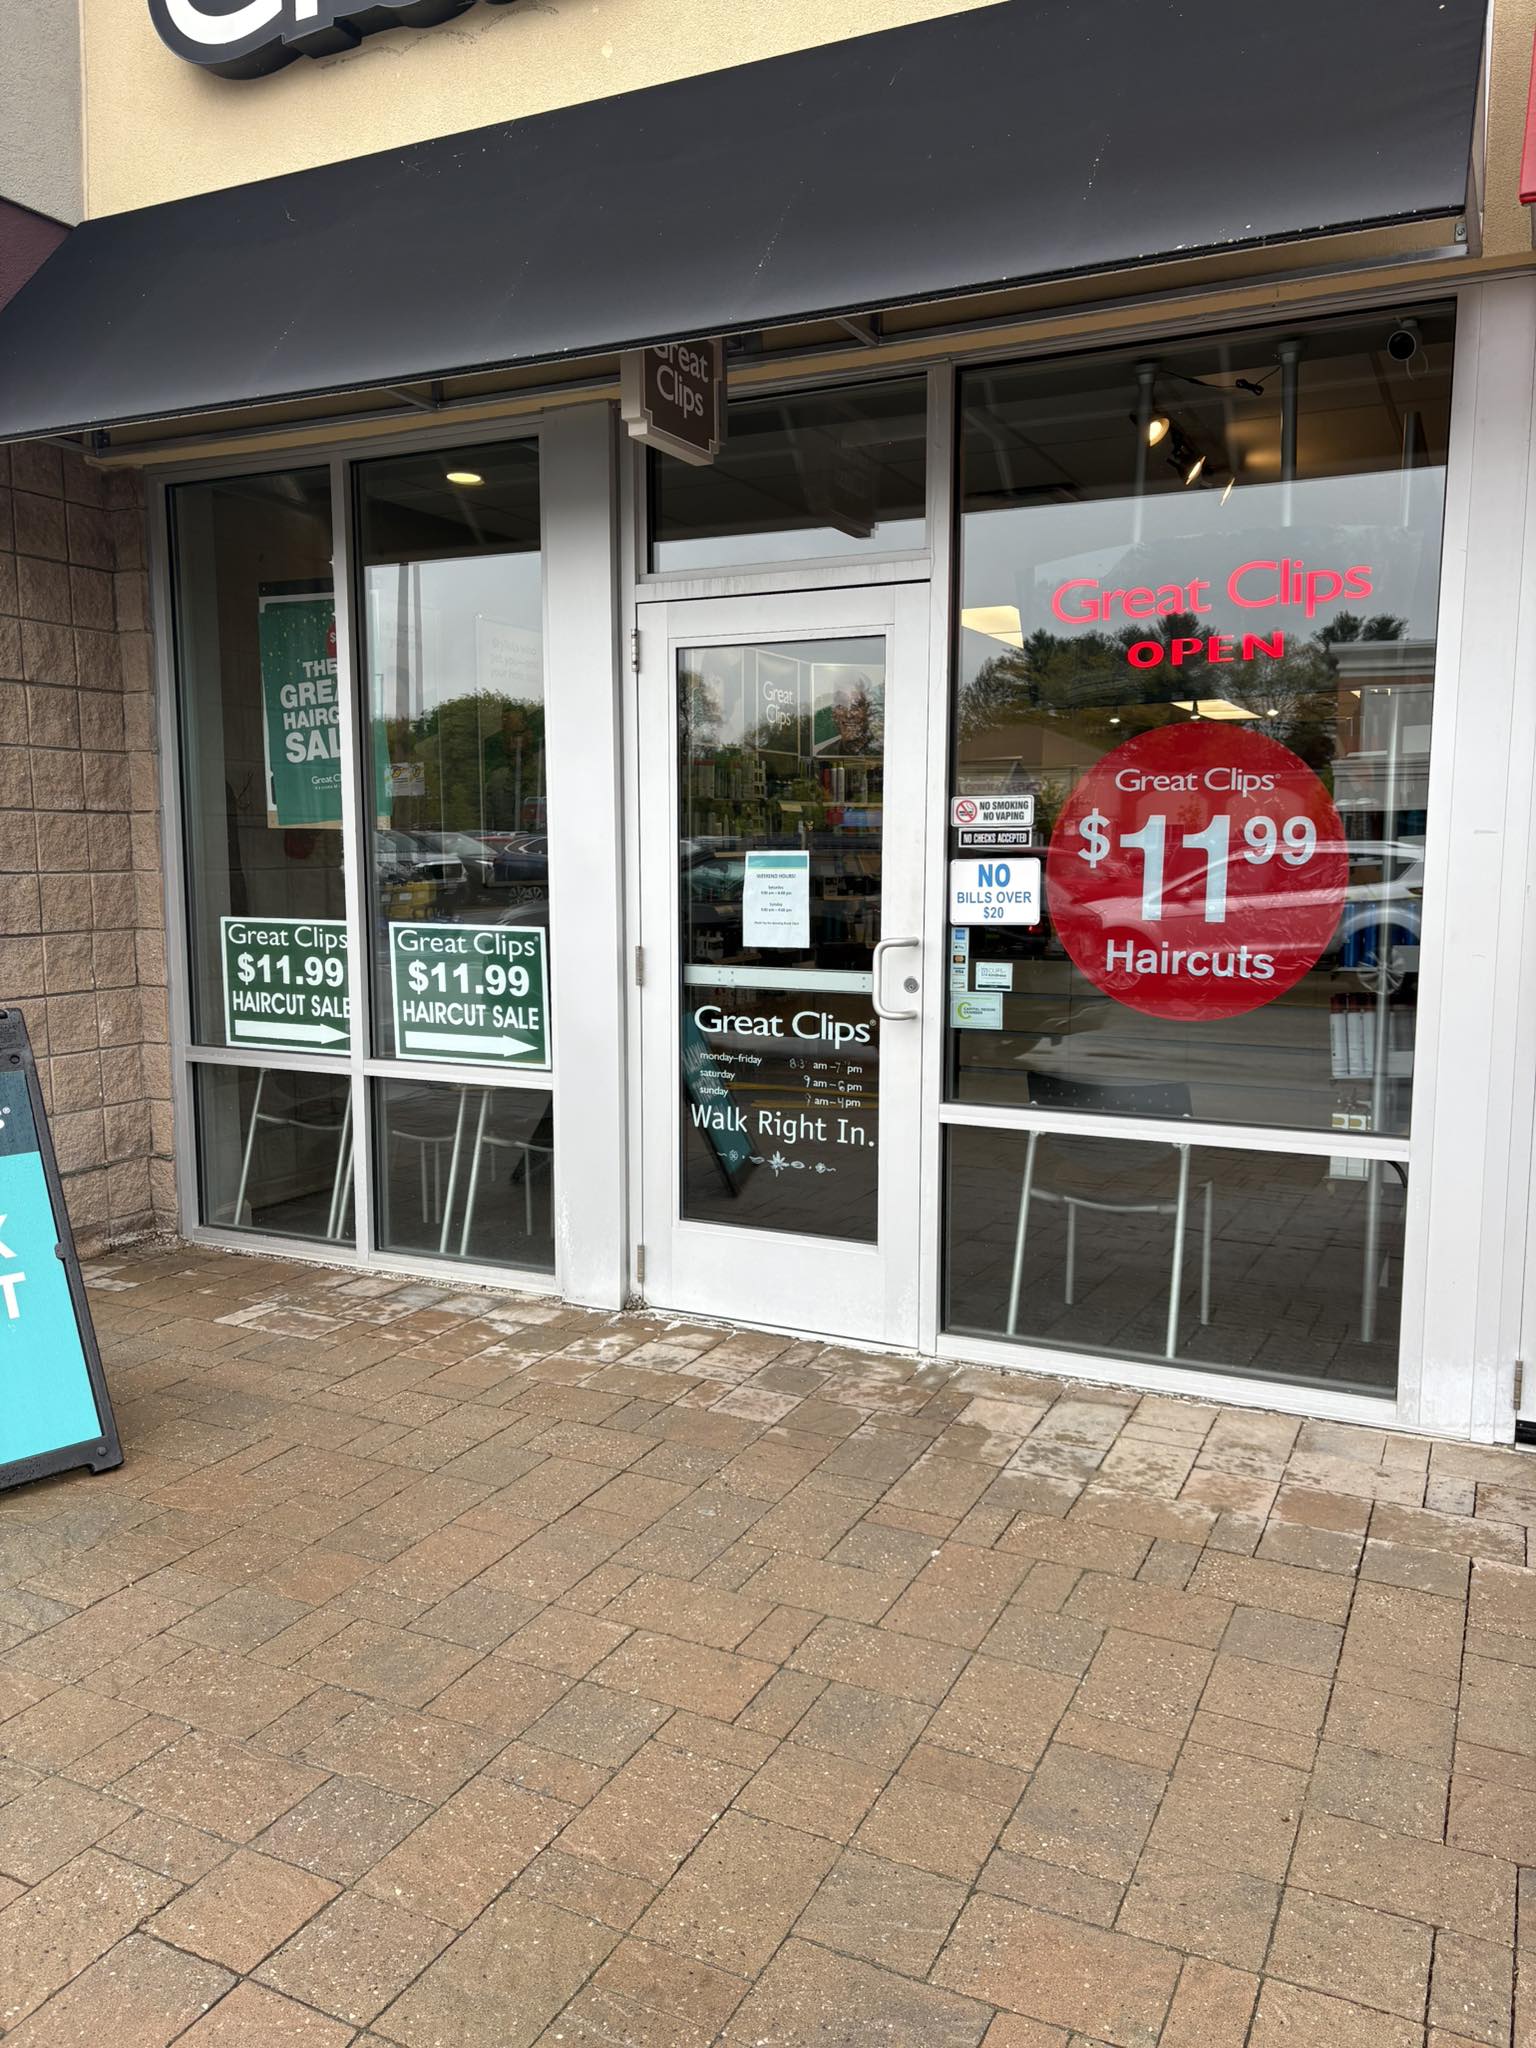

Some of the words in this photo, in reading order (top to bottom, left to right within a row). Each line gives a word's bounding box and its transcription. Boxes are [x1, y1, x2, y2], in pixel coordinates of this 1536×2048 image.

[656, 365, 704, 419] Clips
[1051, 577, 1212, 625] Great
[1227, 558, 1373, 618] Clips
[1126, 631, 1285, 669] OPEN
[302, 658, 338, 678] THE
[280, 679, 339, 709] GRE
[763, 680, 794, 706] Great
[283, 705, 340, 731] HAIRC
[765, 703, 791, 731] Clips
[285, 727, 341, 764] SAL
[1115, 768, 1200, 792] Great
[979, 801, 991, 810] NO
[992, 801, 1029, 810] SMOKING
[983, 812, 994, 821] NO
[995, 811, 1025, 820] VAPING
[963, 833, 972, 843] NO
[973, 833, 996, 843] CHECKS
[997, 833, 1027, 843] ACCEPTED
[978, 863, 1011, 888] NO
[957, 892, 992, 904] BILLS
[996, 891, 1032, 904] OVER
[983, 906, 1004, 919] $20
[228, 923, 289, 947] Great
[294, 925, 348, 951] Clips
[397, 929, 468, 955] Great
[237, 952, 344, 988] $11.99
[1105, 938, 1276, 980] Haircuts
[408, 959, 530, 997] $11.99
[233, 990, 306, 1017] HAIRCUT
[311, 994, 351, 1019] SALE
[403, 1000, 486, 1027] HAIRCUT
[492, 1005, 540, 1030] SALE
[694, 1005, 784, 1038] Great
[700, 1069, 735, 1081] saturday
[813, 1080, 828, 1088] am
[846, 1084, 863, 1093] pm
[813, 1062, 828, 1070] am
[847, 1066, 863, 1075] pm
[700, 1086, 729, 1098] sunday
[814, 1097, 829, 1106] am
[845, 1099, 861, 1109] pm
[691, 1103, 748, 1133] Walk
[758, 1110, 827, 1144] Right
[836, 1118, 875, 1147] In.
